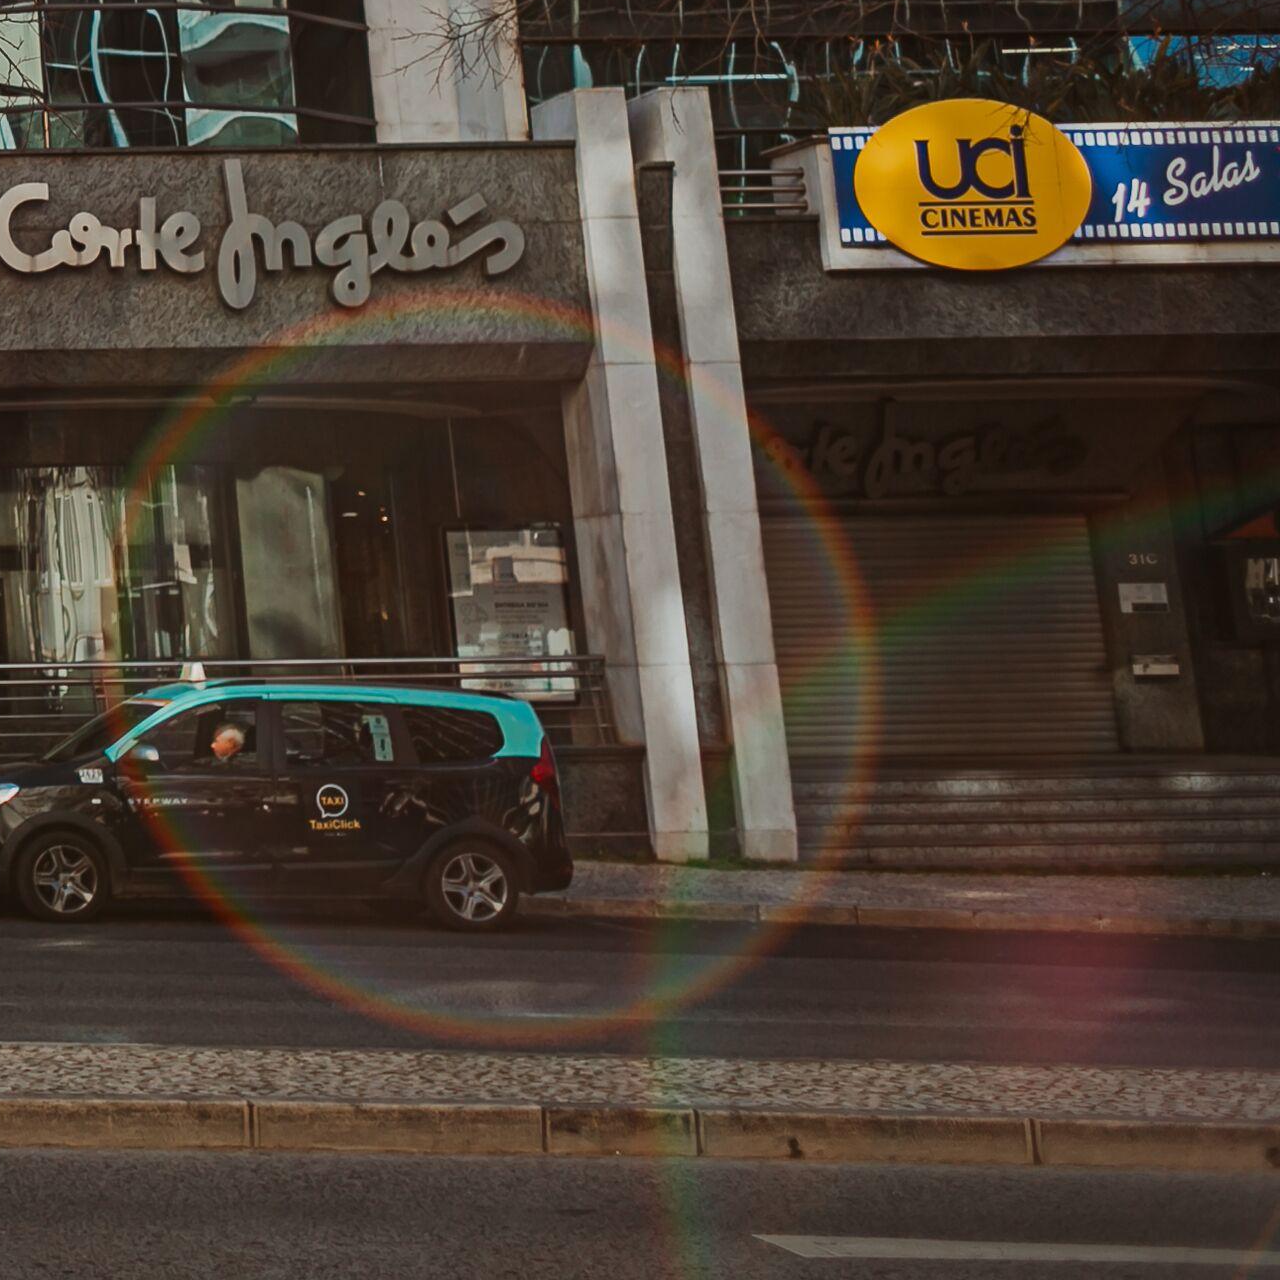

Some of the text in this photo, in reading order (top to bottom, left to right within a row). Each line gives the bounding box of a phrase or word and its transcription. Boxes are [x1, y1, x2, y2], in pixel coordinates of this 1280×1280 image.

[1111, 146, 1261, 223] 14 Salas
[920, 206, 1037, 229] CINEMAS
[217, 158, 526, 310] Inglés
[1128, 553, 1158, 566] 31C
[320, 797, 344, 805] TAXI
[308, 819, 361, 830] TaxiClick
